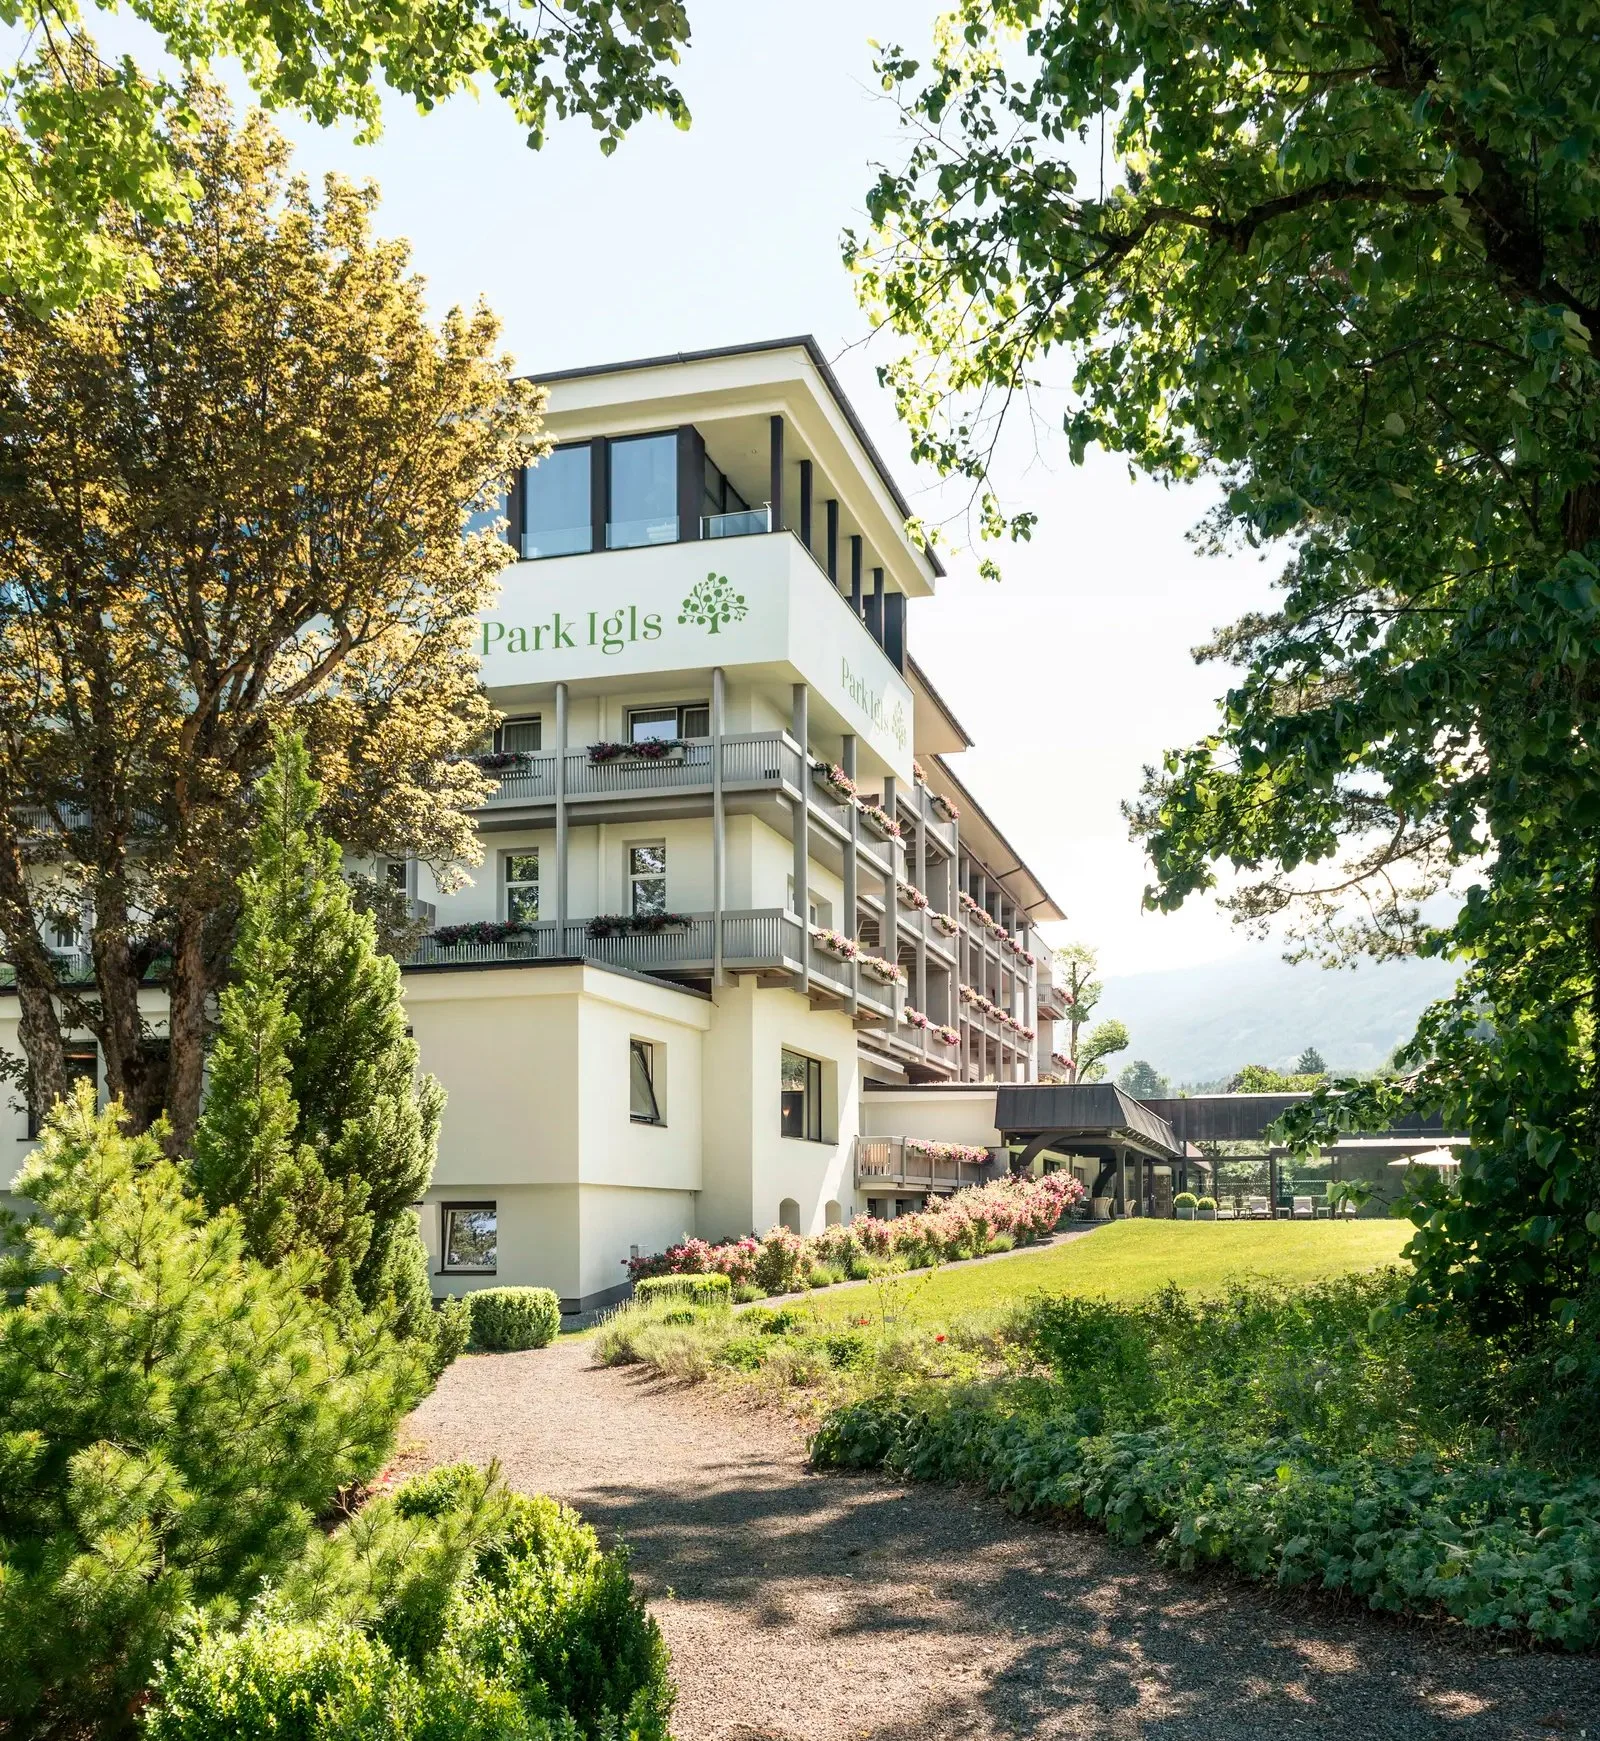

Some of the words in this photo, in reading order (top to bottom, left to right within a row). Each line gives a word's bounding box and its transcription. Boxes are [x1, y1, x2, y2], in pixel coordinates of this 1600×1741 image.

[480, 612, 578, 656] Park
[586, 605, 662, 655] Igls
[841, 656, 868, 714] Park
[870, 690, 889, 736] Igls
